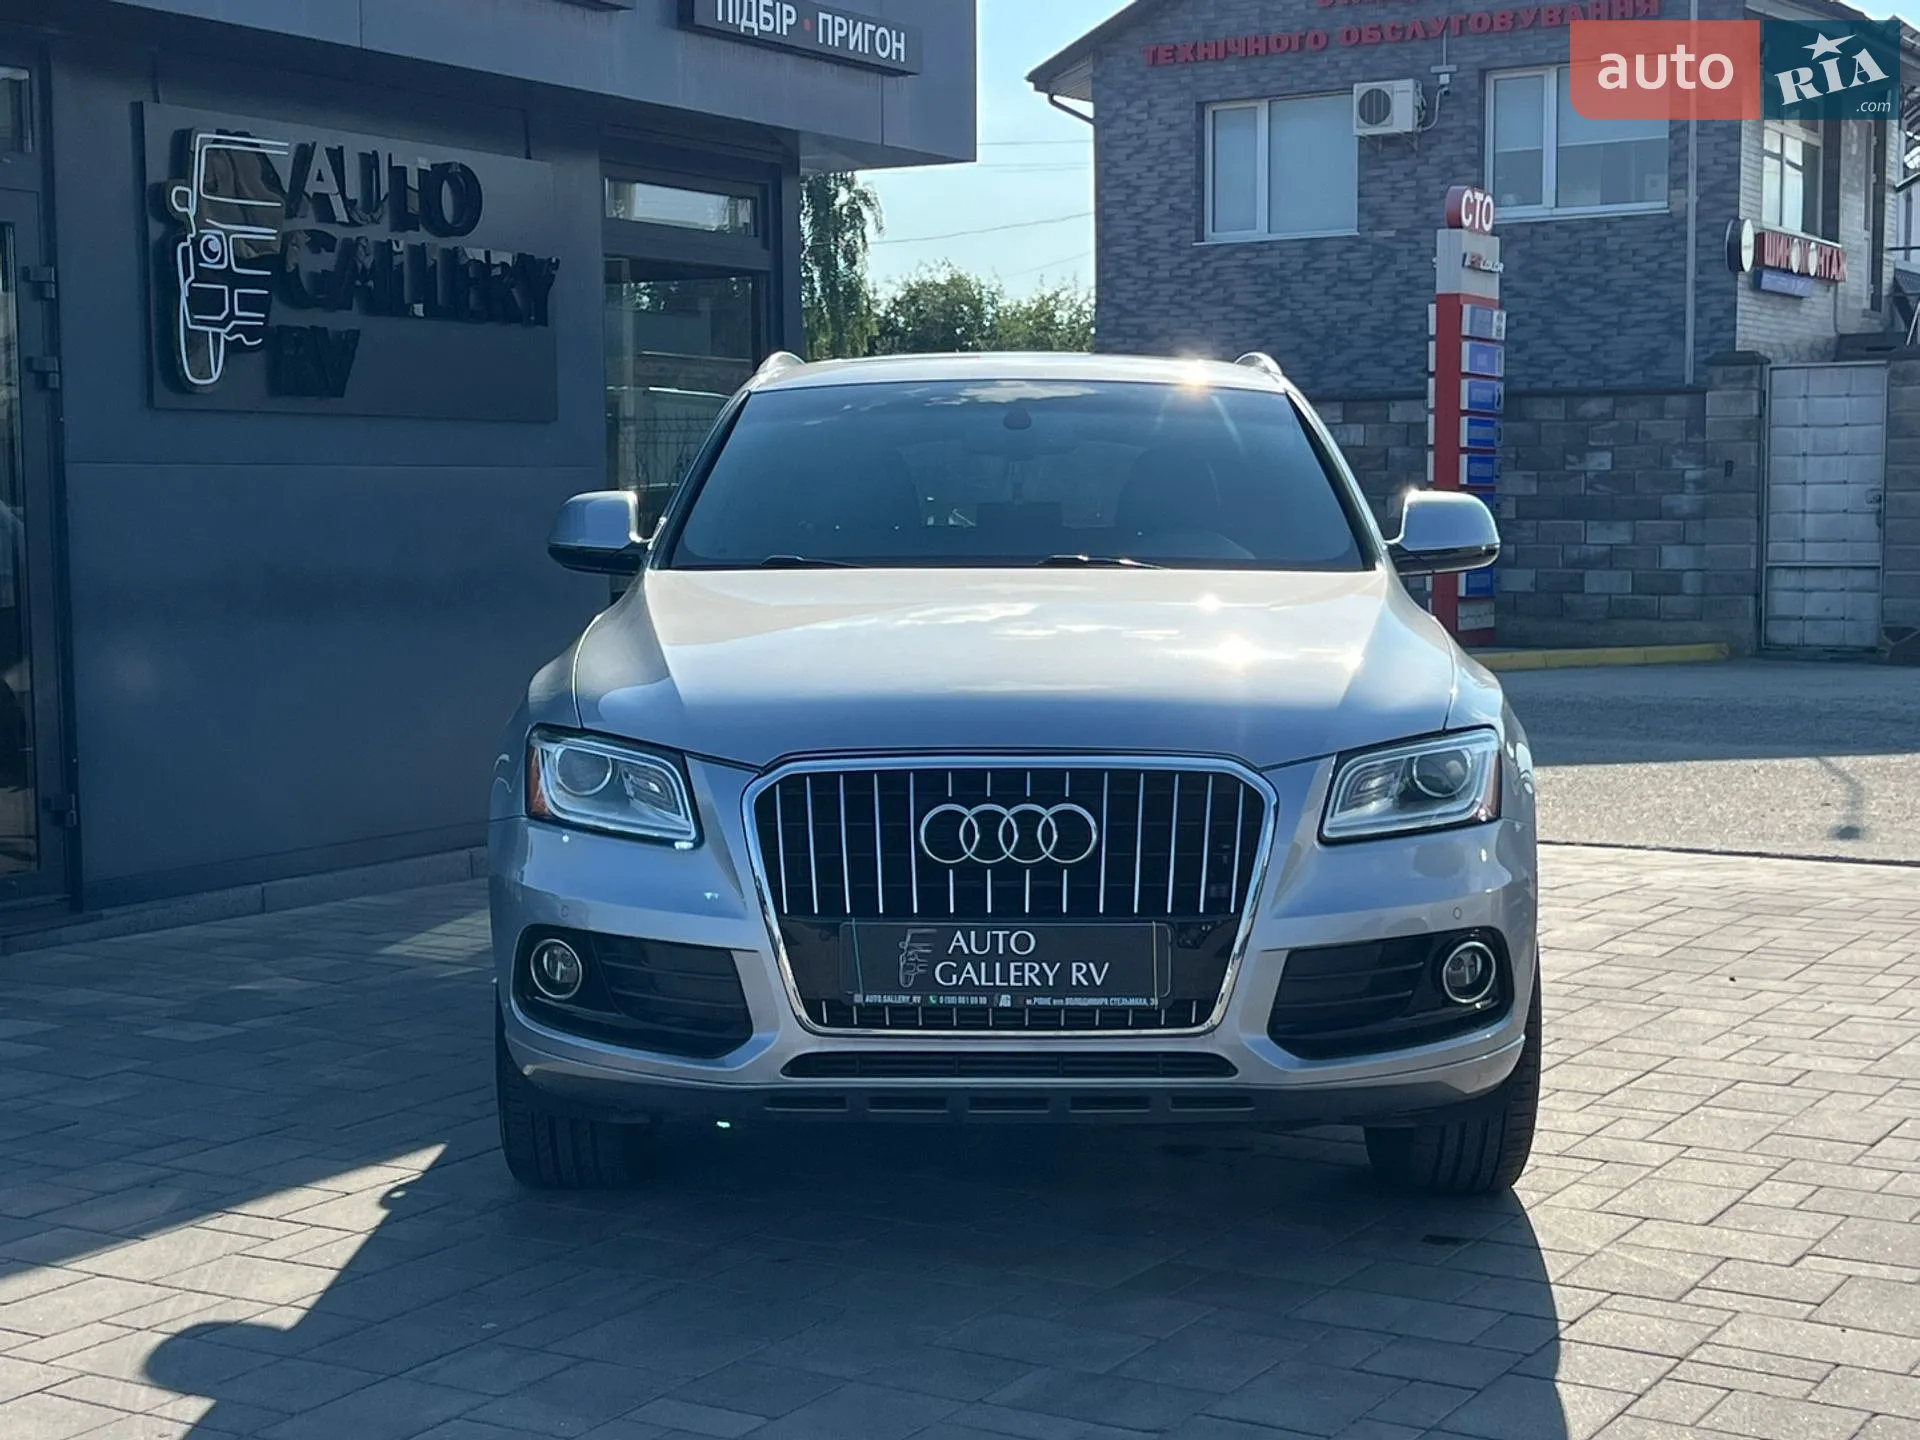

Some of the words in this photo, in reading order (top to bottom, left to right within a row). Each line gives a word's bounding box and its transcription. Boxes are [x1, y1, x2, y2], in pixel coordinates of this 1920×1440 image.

[817, 12, 906, 63] ПРИГОН
[1143, 29, 1328, 66] ТЕХНІЧНОГО
[1338, 0, 1661, 47] ОБСЛУГОВУВАННЯ
[284, 141, 483, 238] AUTO
[1460, 189, 1495, 232] СТО
[275, 228, 560, 328] GALLERY
[266, 324, 361, 398] RV
[948, 930, 1036, 955] AUTO
[934, 961, 1061, 987] GALLERY
[1071, 961, 1110, 987] RV
